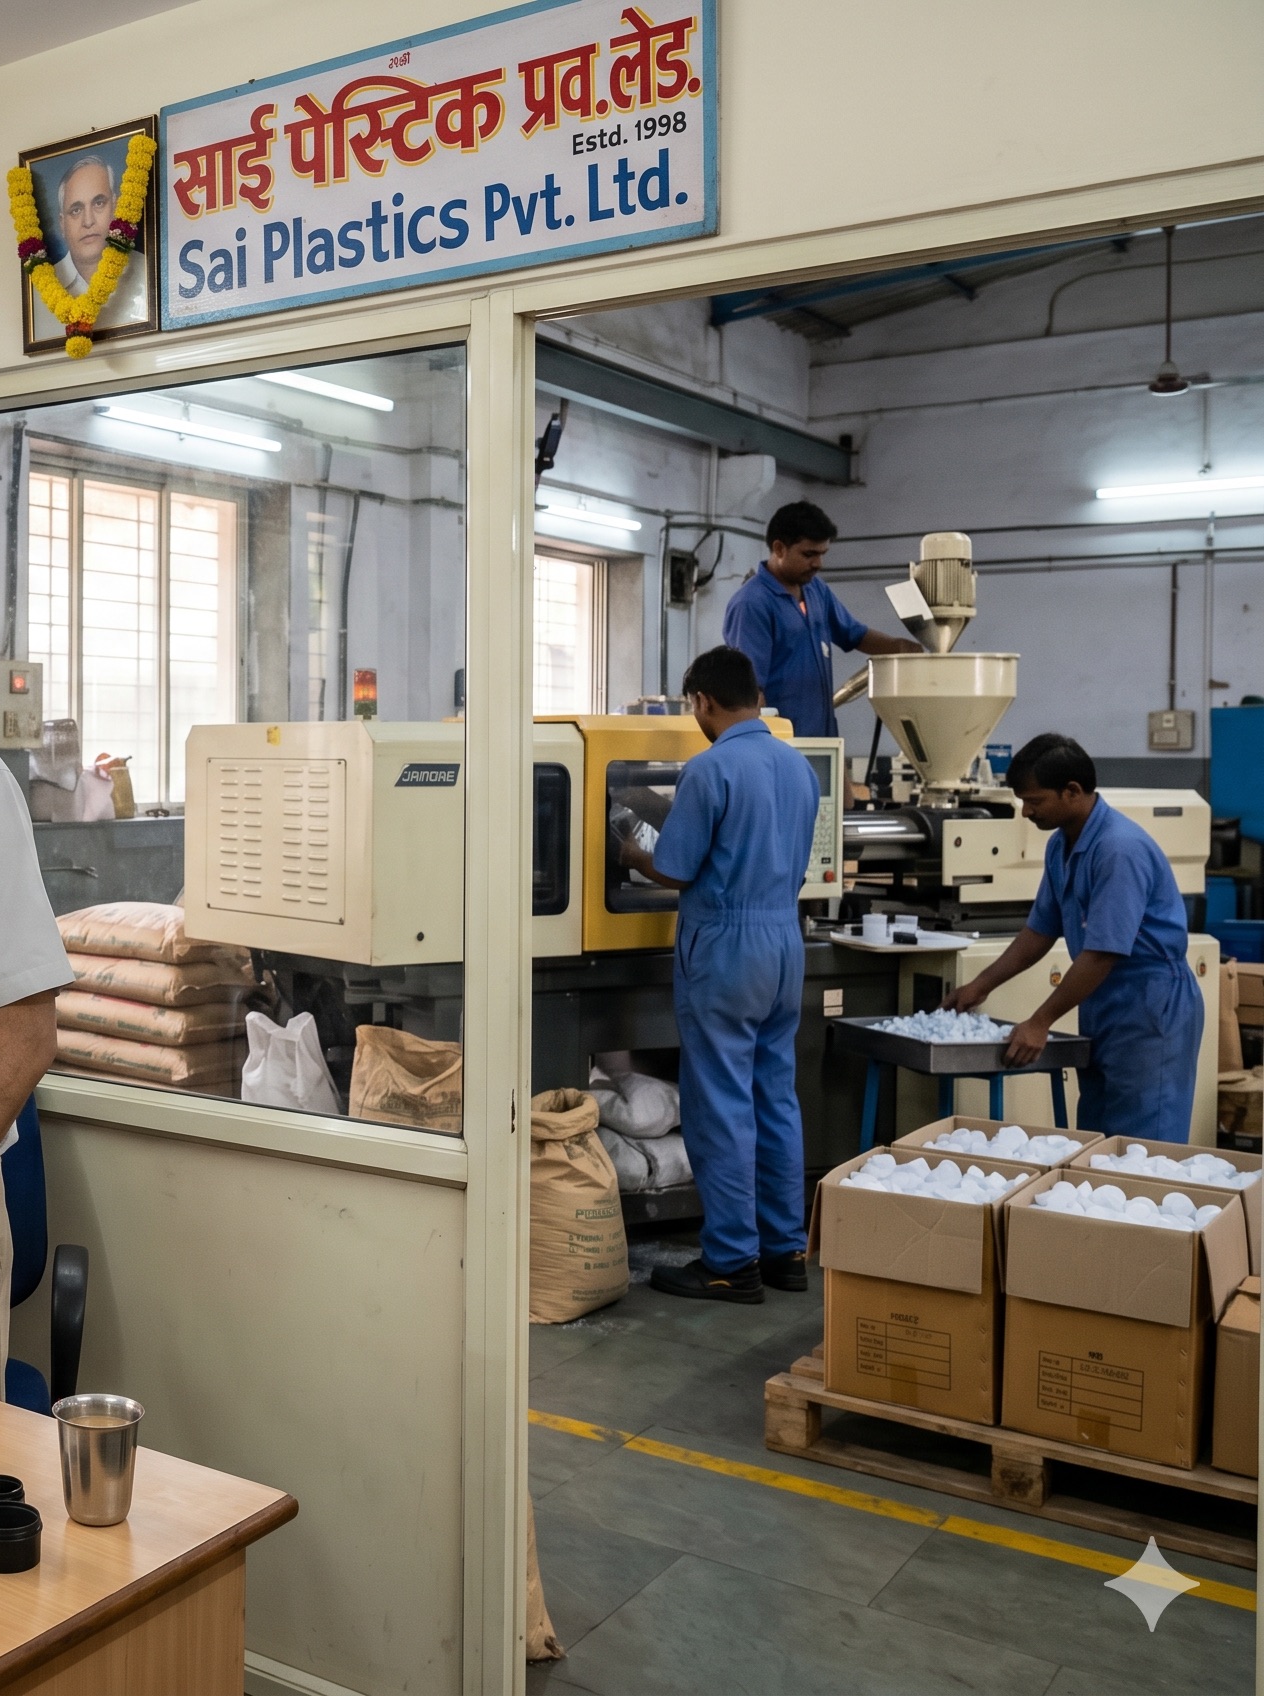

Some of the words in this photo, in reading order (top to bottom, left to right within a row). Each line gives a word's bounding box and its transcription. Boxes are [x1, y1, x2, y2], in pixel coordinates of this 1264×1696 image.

[173, 103, 276, 218] साई
[572, 123, 629, 155] Estd.
[635, 111, 687, 142] 1998
[178, 226, 247, 299] Sai
[263, 192, 470, 284] Plastics
[484, 173, 575, 242] Pvt.
[588, 147, 689, 223] Ltd.
